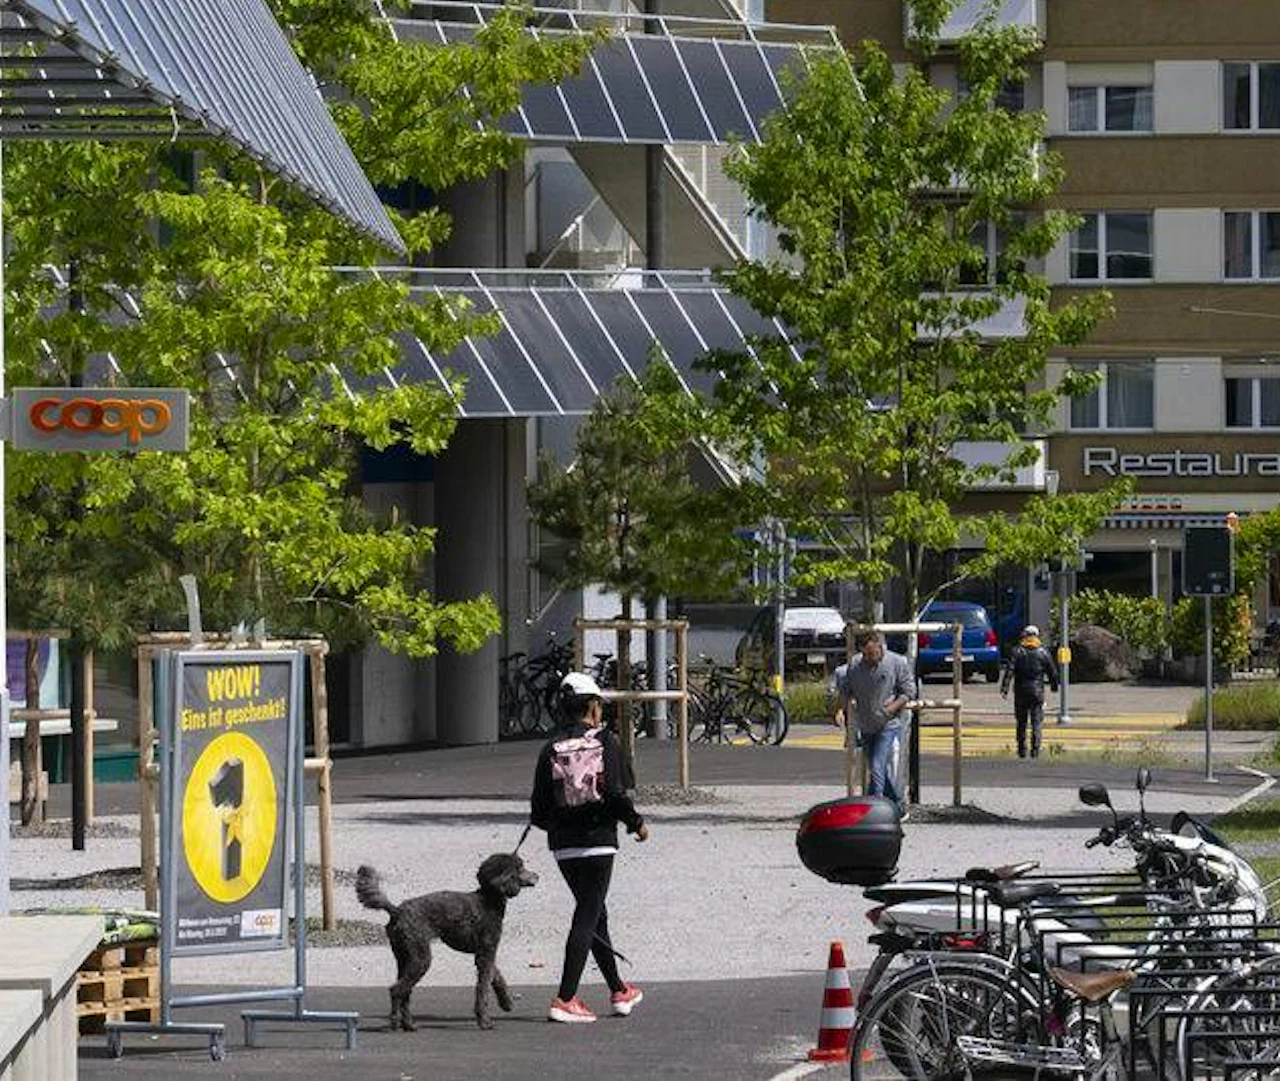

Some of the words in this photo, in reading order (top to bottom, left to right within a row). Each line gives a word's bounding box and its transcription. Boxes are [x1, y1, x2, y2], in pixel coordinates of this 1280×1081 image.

[31, 399, 172, 442] coop
[206, 664, 260, 702] WOW!
[180, 706, 207, 732] Eins
[207, 705, 223, 728] ist
[225, 695, 286, 731] geschenkt!
